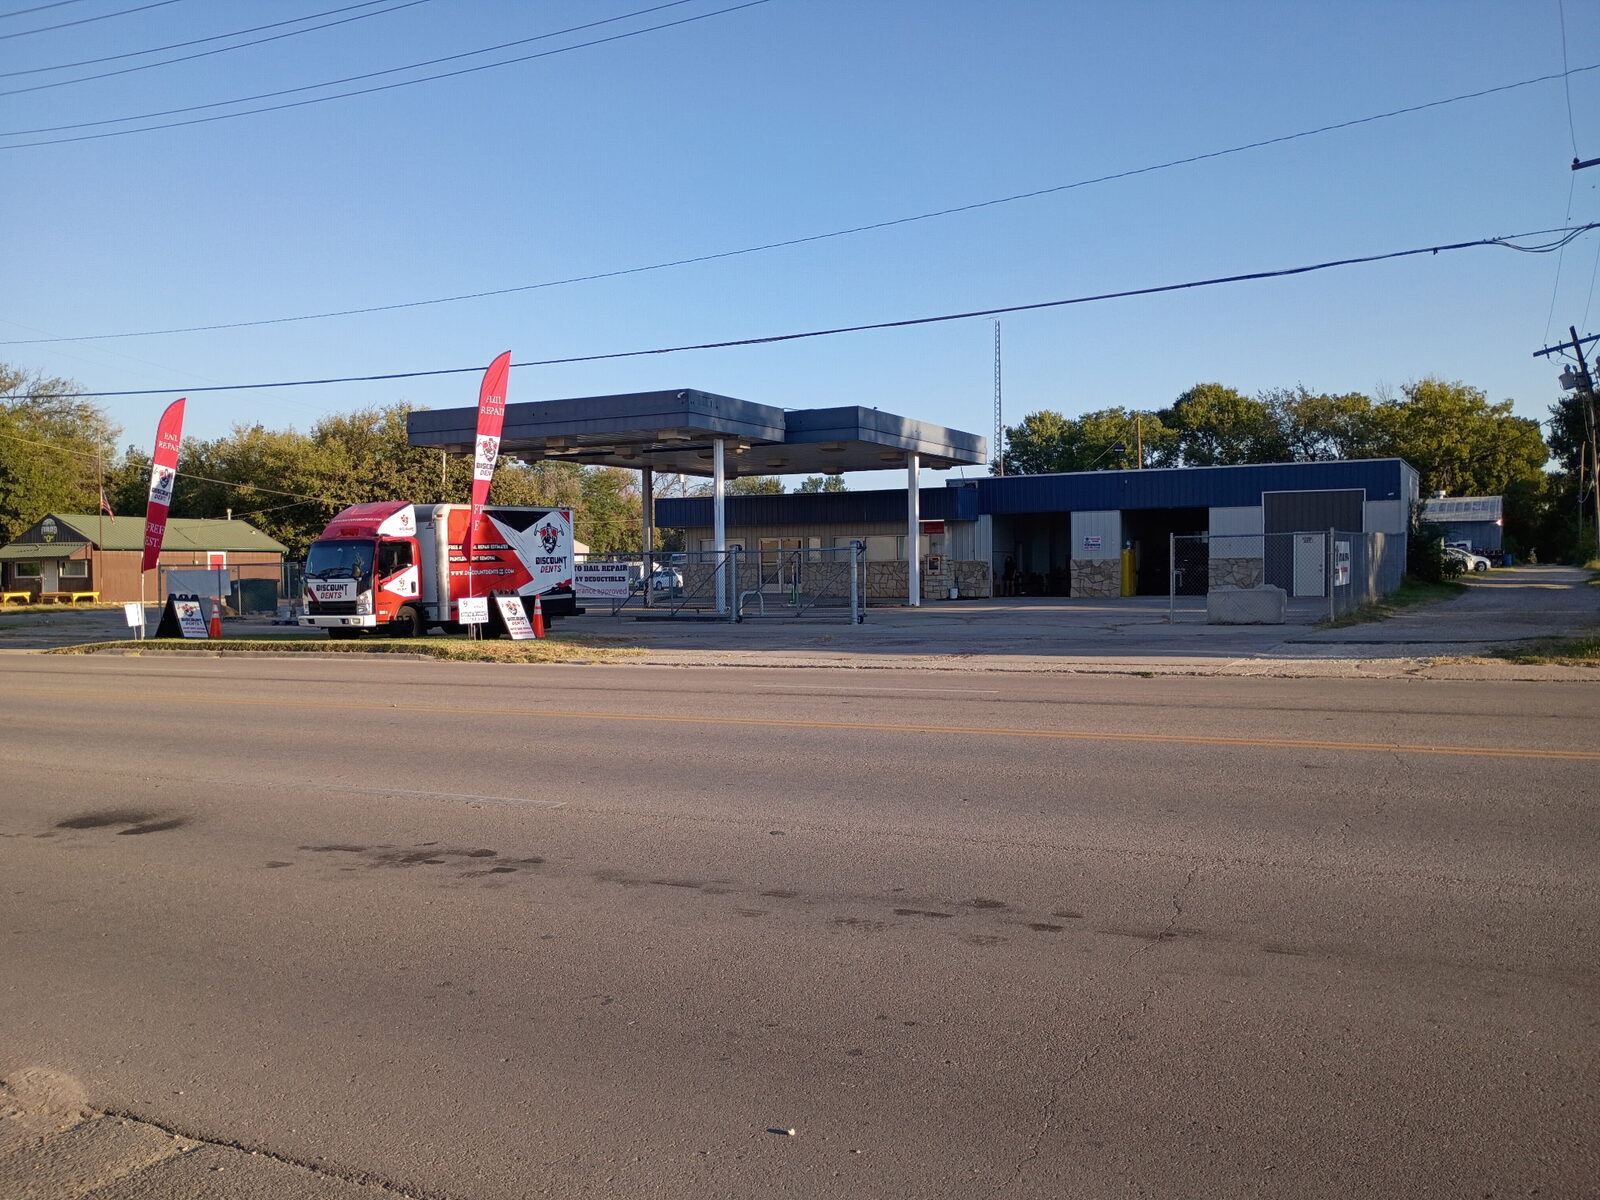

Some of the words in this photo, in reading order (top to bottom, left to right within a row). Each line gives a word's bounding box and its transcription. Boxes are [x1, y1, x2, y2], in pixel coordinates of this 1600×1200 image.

[535, 556, 567, 569] DISCOUNT
[540, 565, 561, 573] DENTS
[601, 564, 628, 572] REPAIR
[316, 583, 348, 596] DISCOUNT
